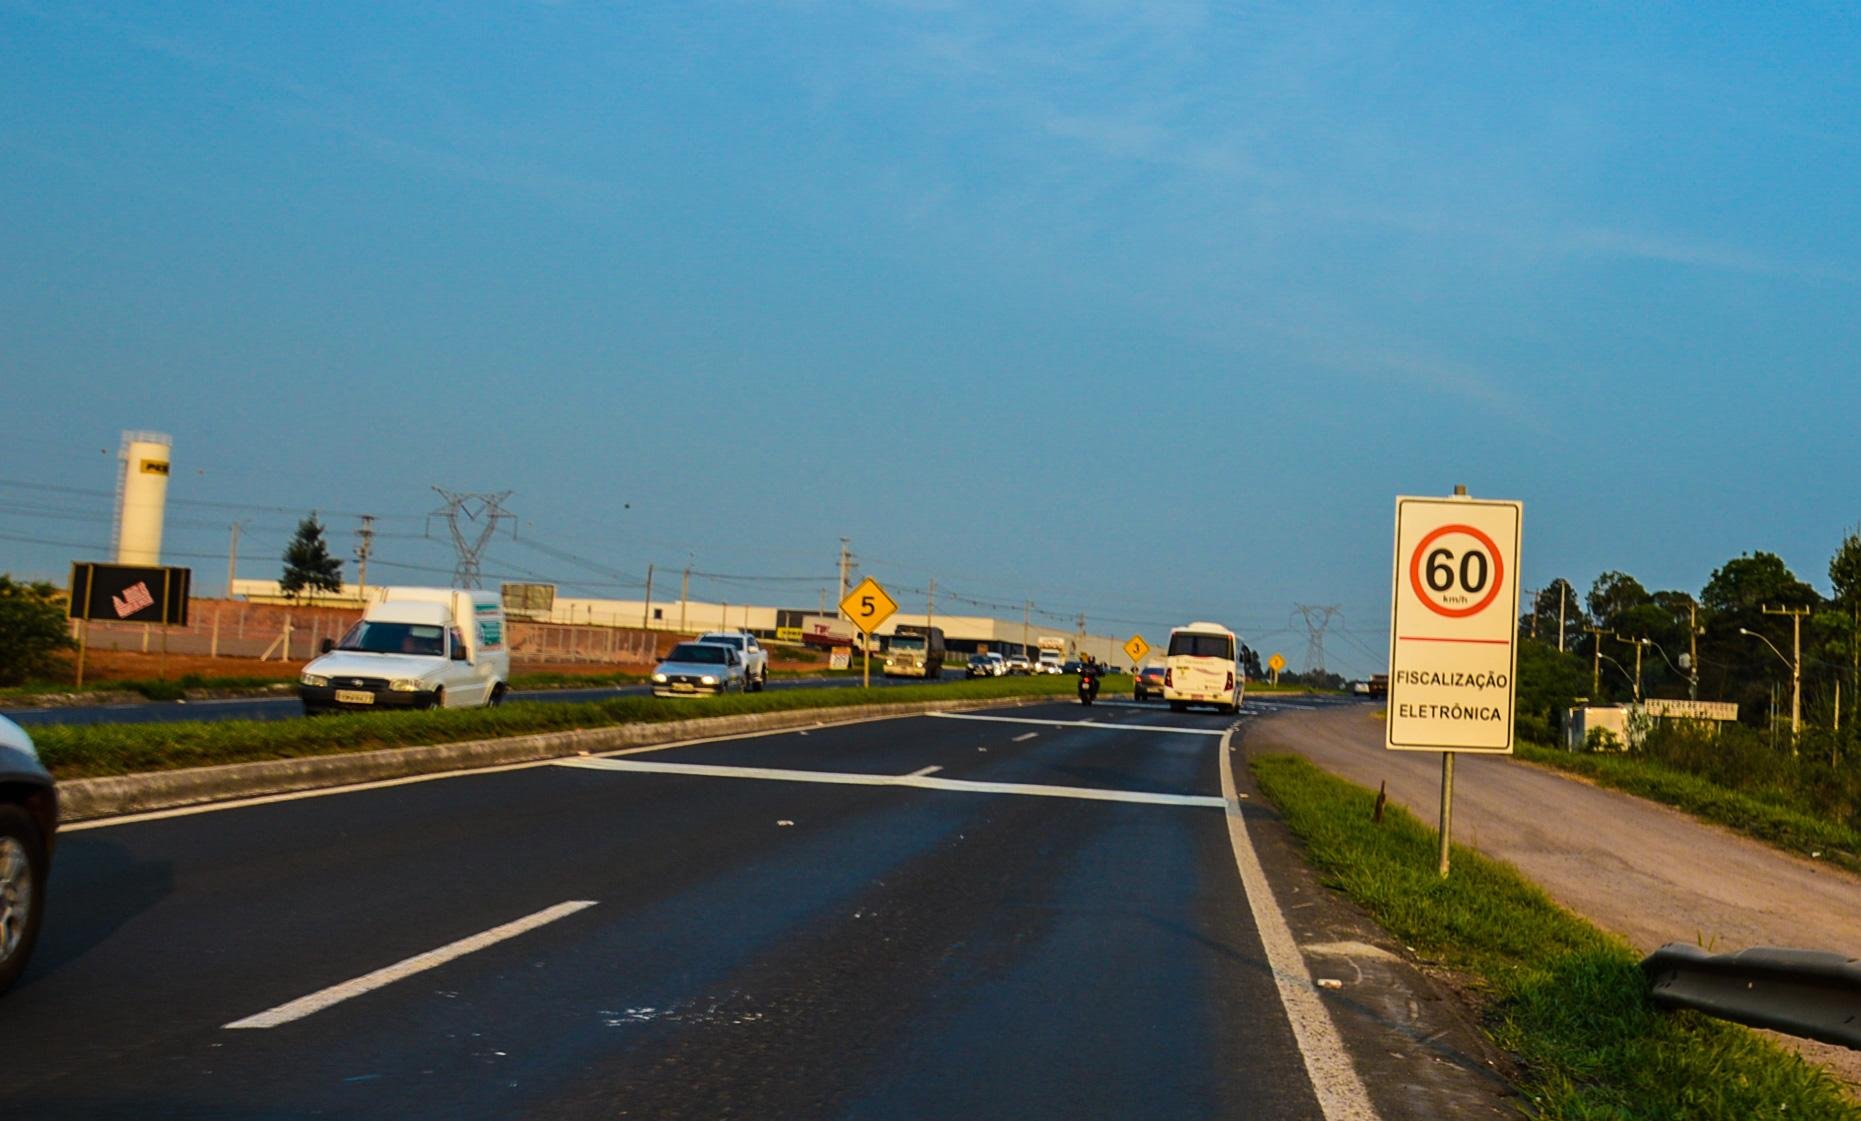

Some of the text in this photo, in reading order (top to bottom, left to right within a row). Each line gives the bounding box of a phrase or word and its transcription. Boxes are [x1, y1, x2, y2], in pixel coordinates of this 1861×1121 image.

[1426, 548, 1488, 593] 60
[861, 596, 875, 617] 5
[1442, 594, 1468, 604] km/h
[1397, 671, 1507, 691] FISCALIZAÇÃO
[1399, 703, 1501, 721] ELETRÔNICA
